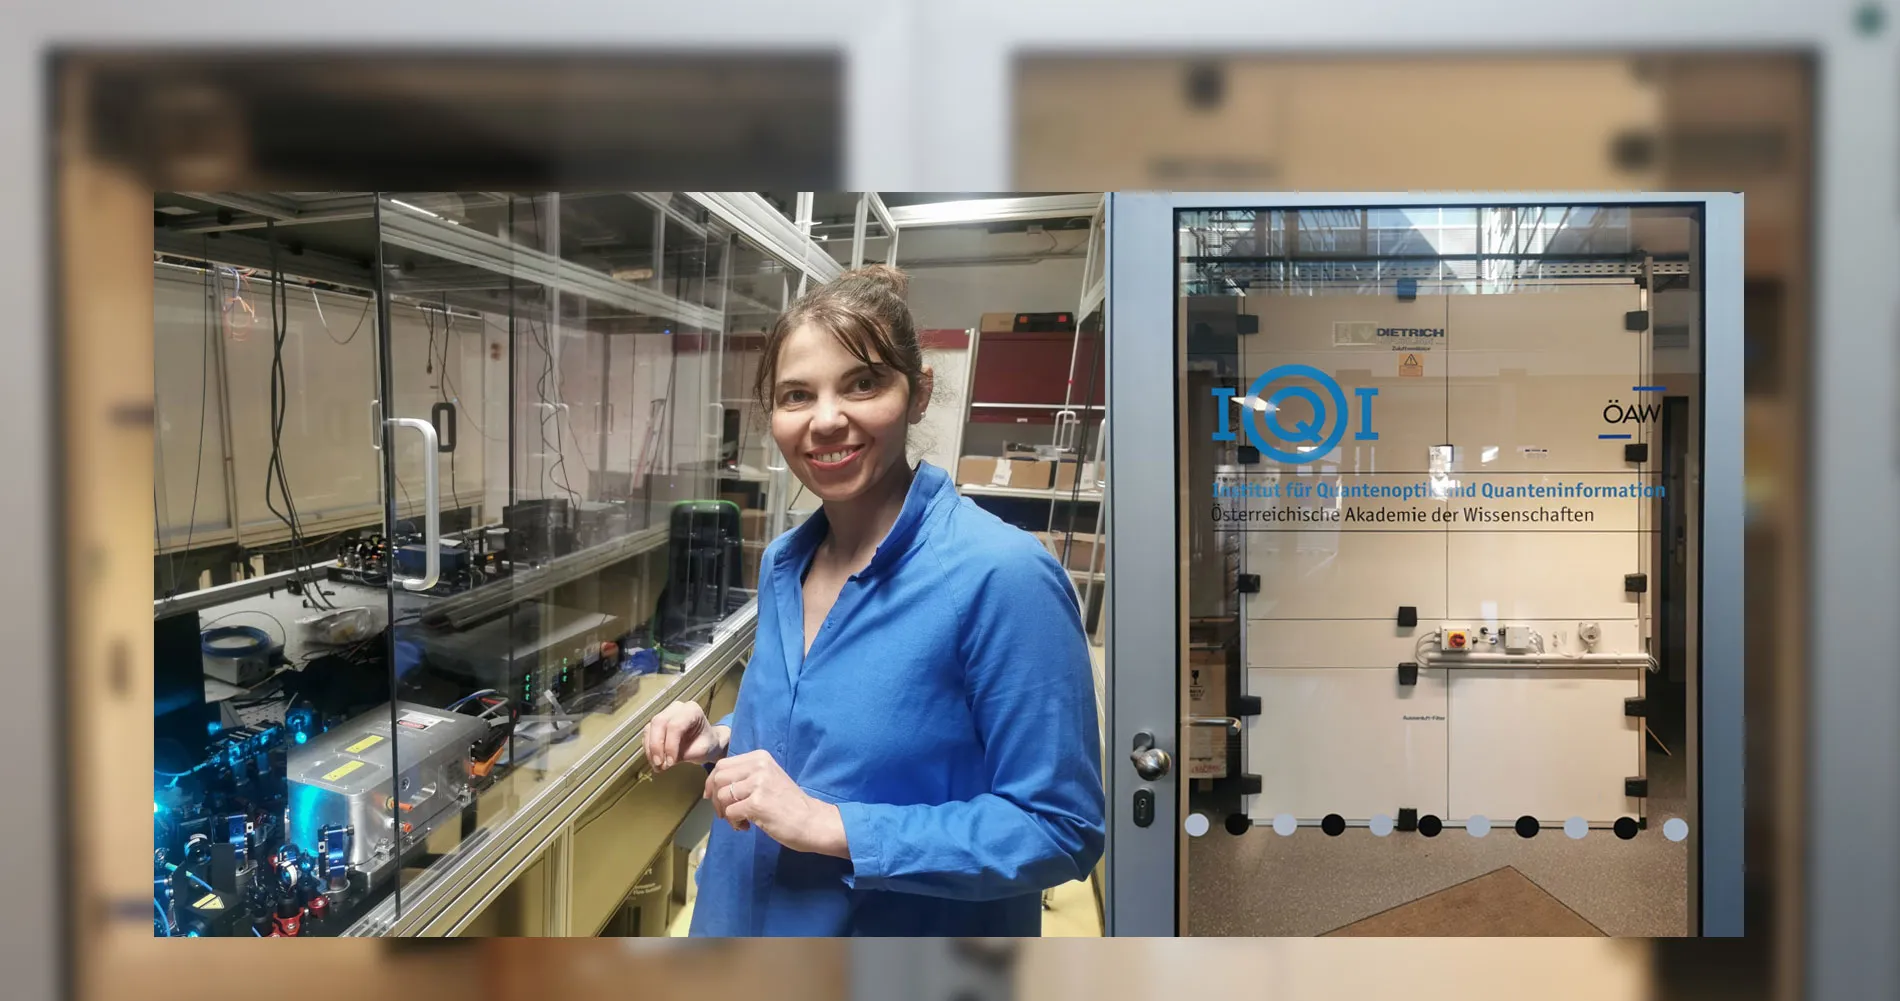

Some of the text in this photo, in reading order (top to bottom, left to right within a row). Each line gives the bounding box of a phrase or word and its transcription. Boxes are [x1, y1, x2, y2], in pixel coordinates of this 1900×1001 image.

[1376, 328, 1444, 337] DIETRICH
[1211, 364, 1379, 465] IQI
[1603, 399, 1661, 424] ÖAW
[1212, 482, 1282, 498] Institut
[1286, 482, 1312, 498] für
[1481, 482, 1666, 498] Quanteninformation
[1211, 504, 1595, 522] Österreichische Akademie der Wissenschaften
